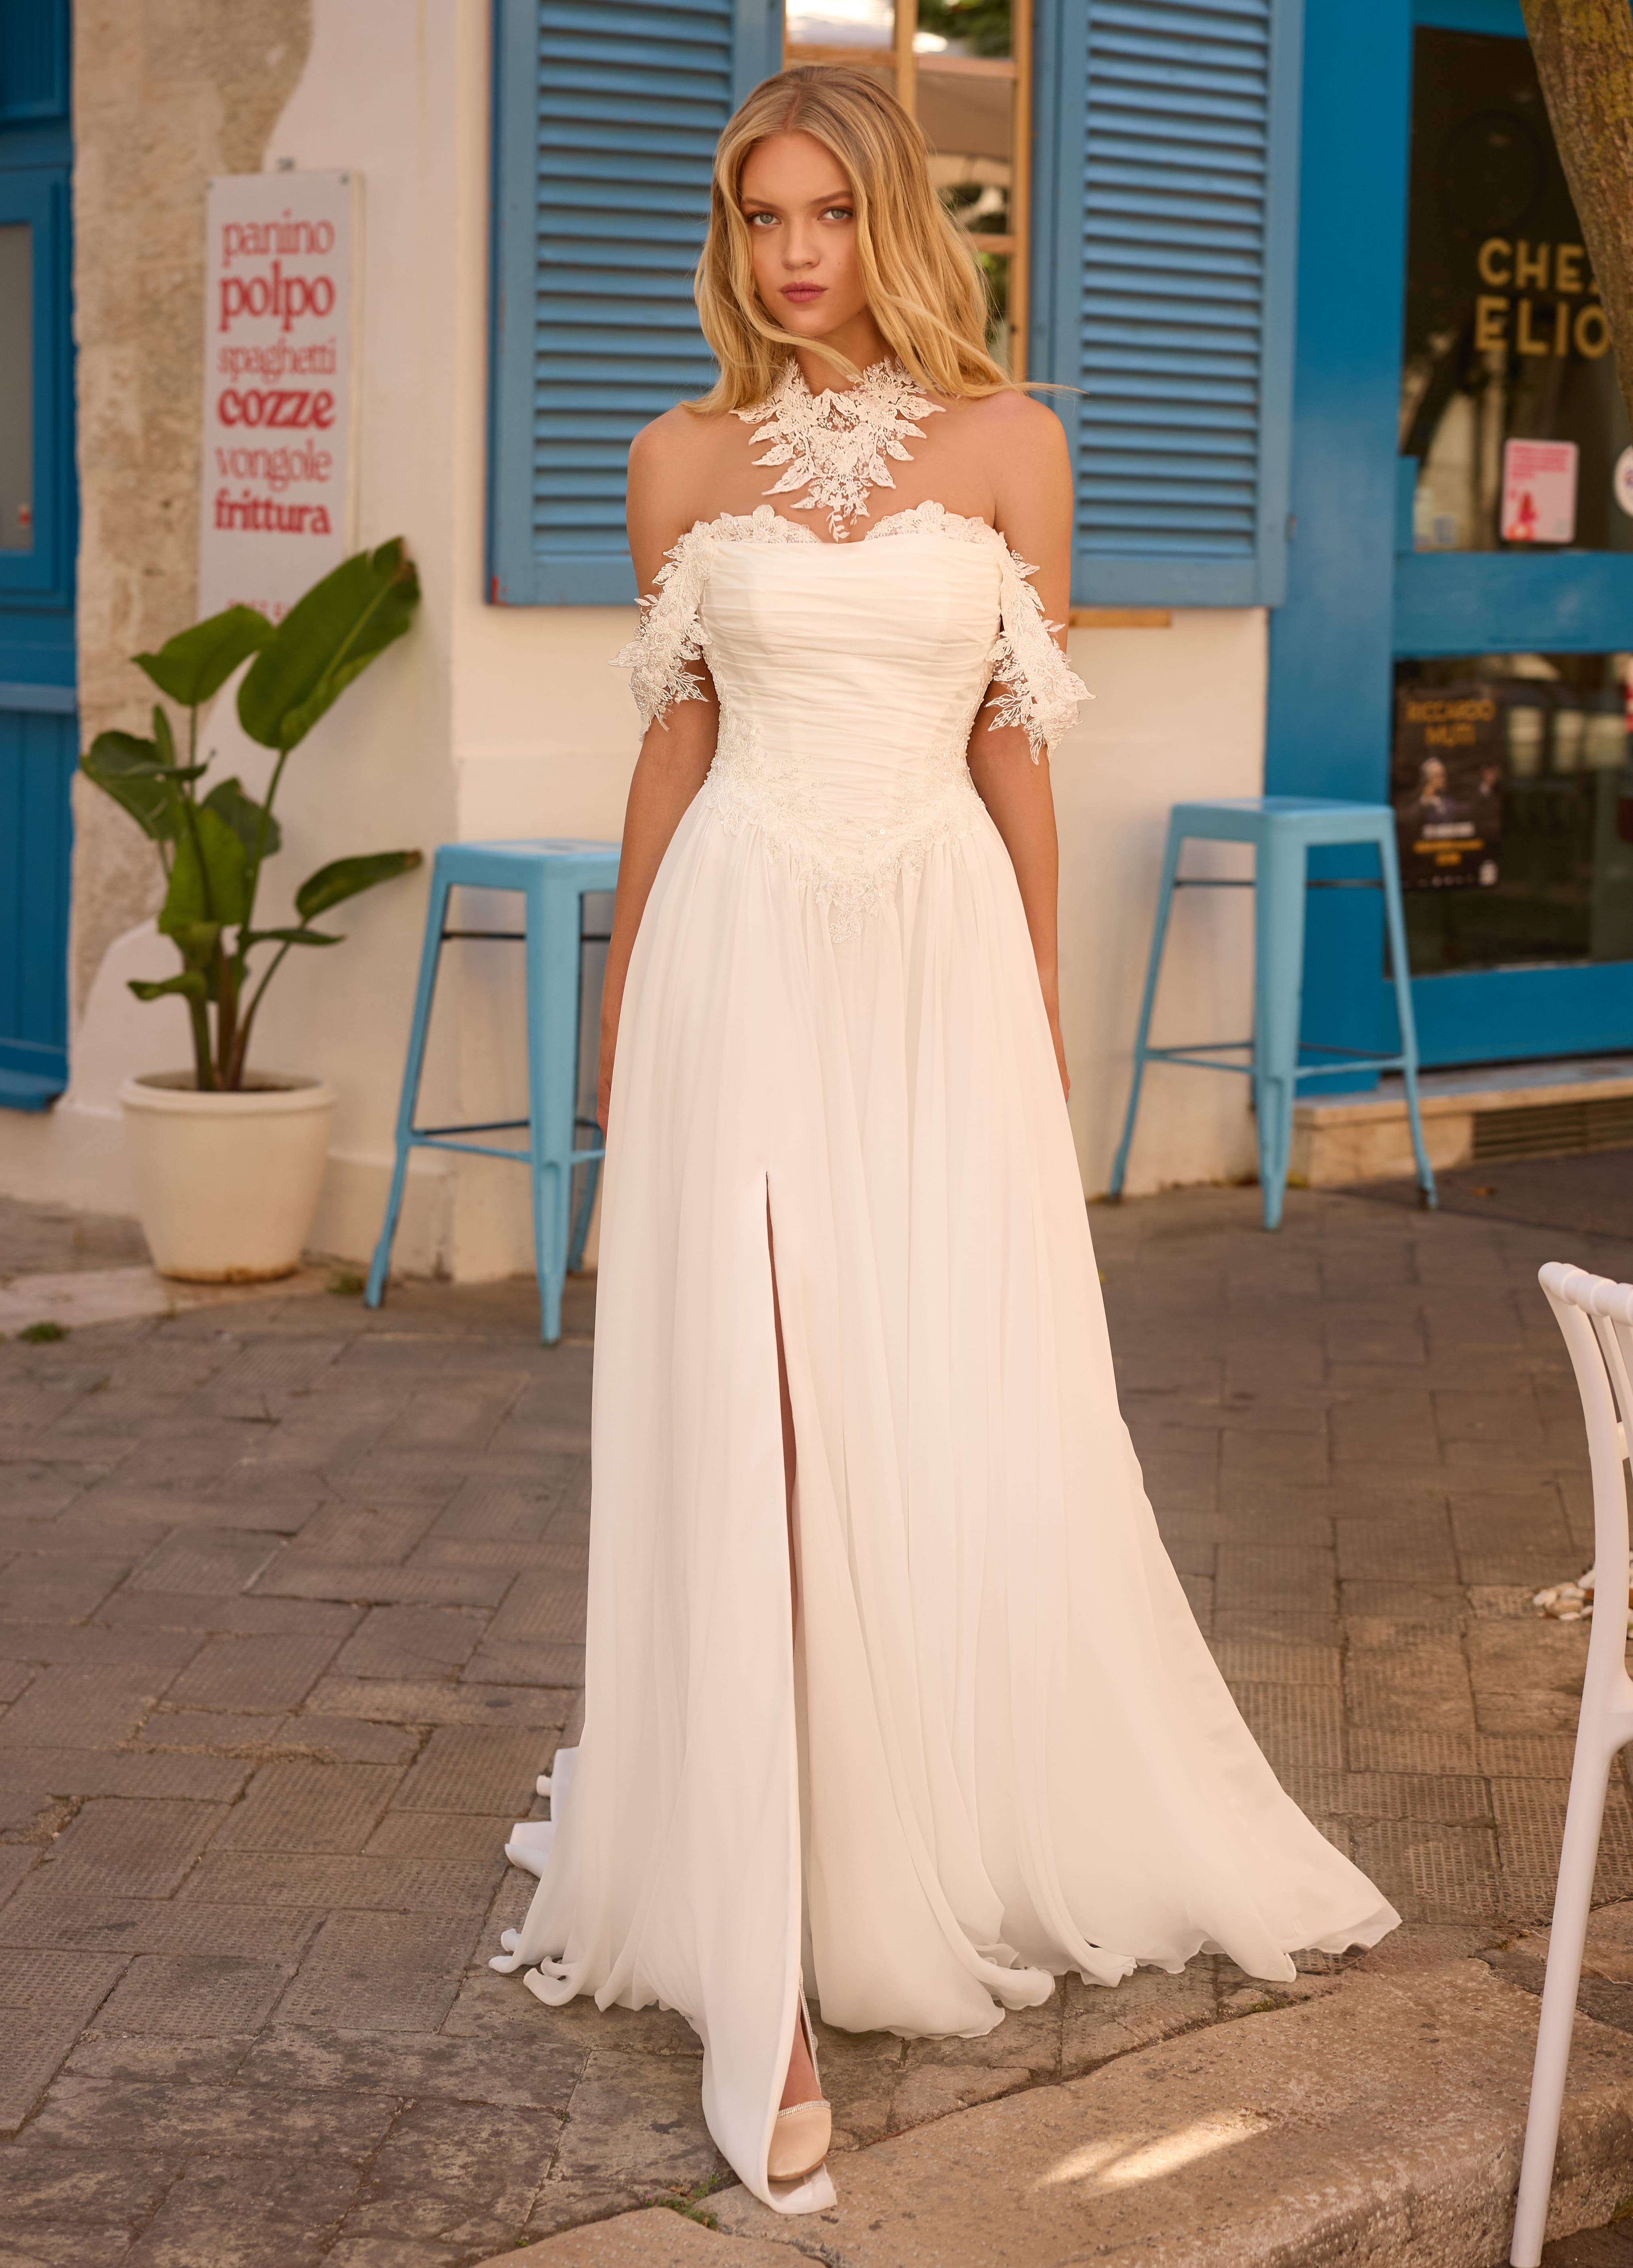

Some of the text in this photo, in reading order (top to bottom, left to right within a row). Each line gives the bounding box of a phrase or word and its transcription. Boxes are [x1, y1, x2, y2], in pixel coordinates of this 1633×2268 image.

[222, 208, 335, 268] panino
[1478, 238, 1599, 295] CHE
[220, 260, 335, 332] polpo
[1474, 295, 1611, 358] ELIO
[218, 337, 337, 383] spaghetti
[218, 389, 335, 429] cozze
[216, 438, 332, 492] vongole
[214, 488, 332, 535] frittura
